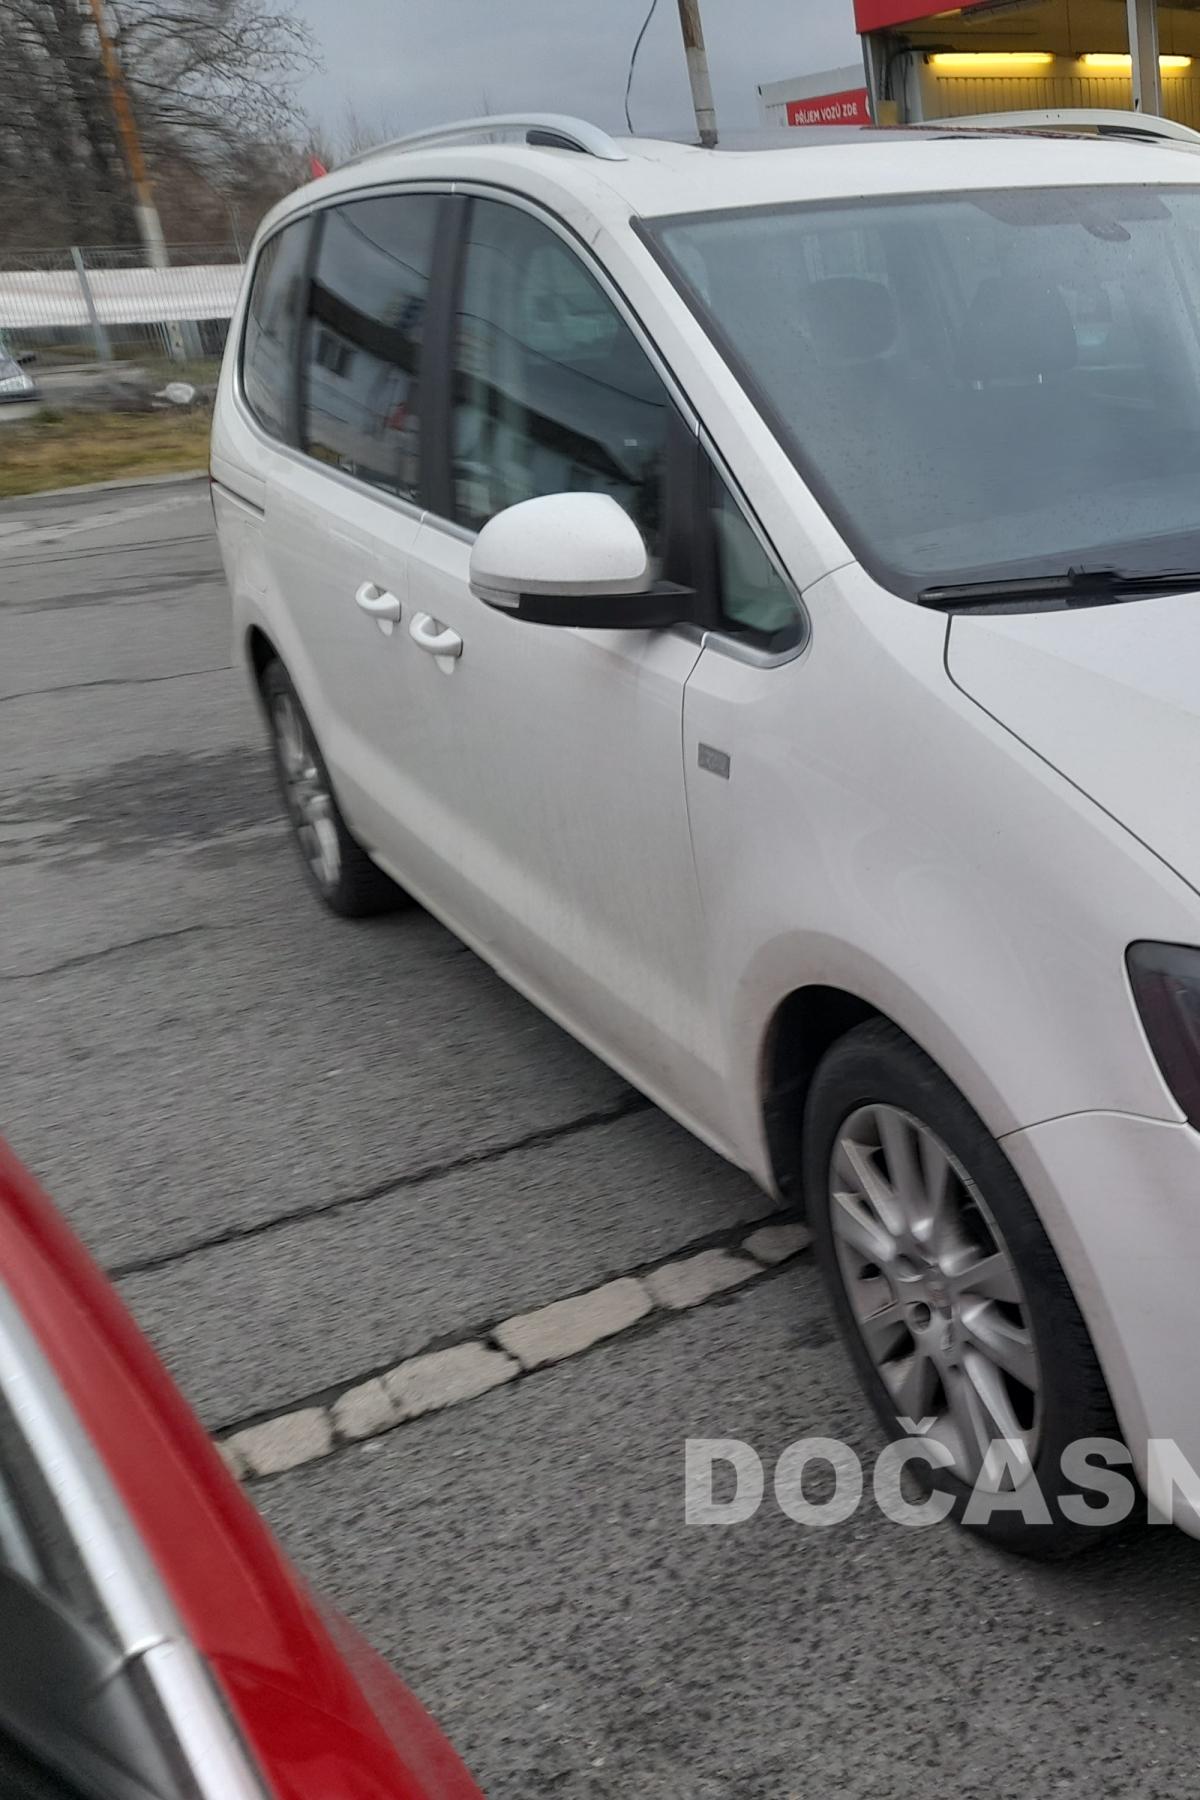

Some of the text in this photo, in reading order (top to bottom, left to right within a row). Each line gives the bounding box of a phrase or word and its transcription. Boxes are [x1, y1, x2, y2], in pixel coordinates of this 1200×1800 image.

[795, 102, 858, 125] PŘÍJEM VOZŮ ZDE
